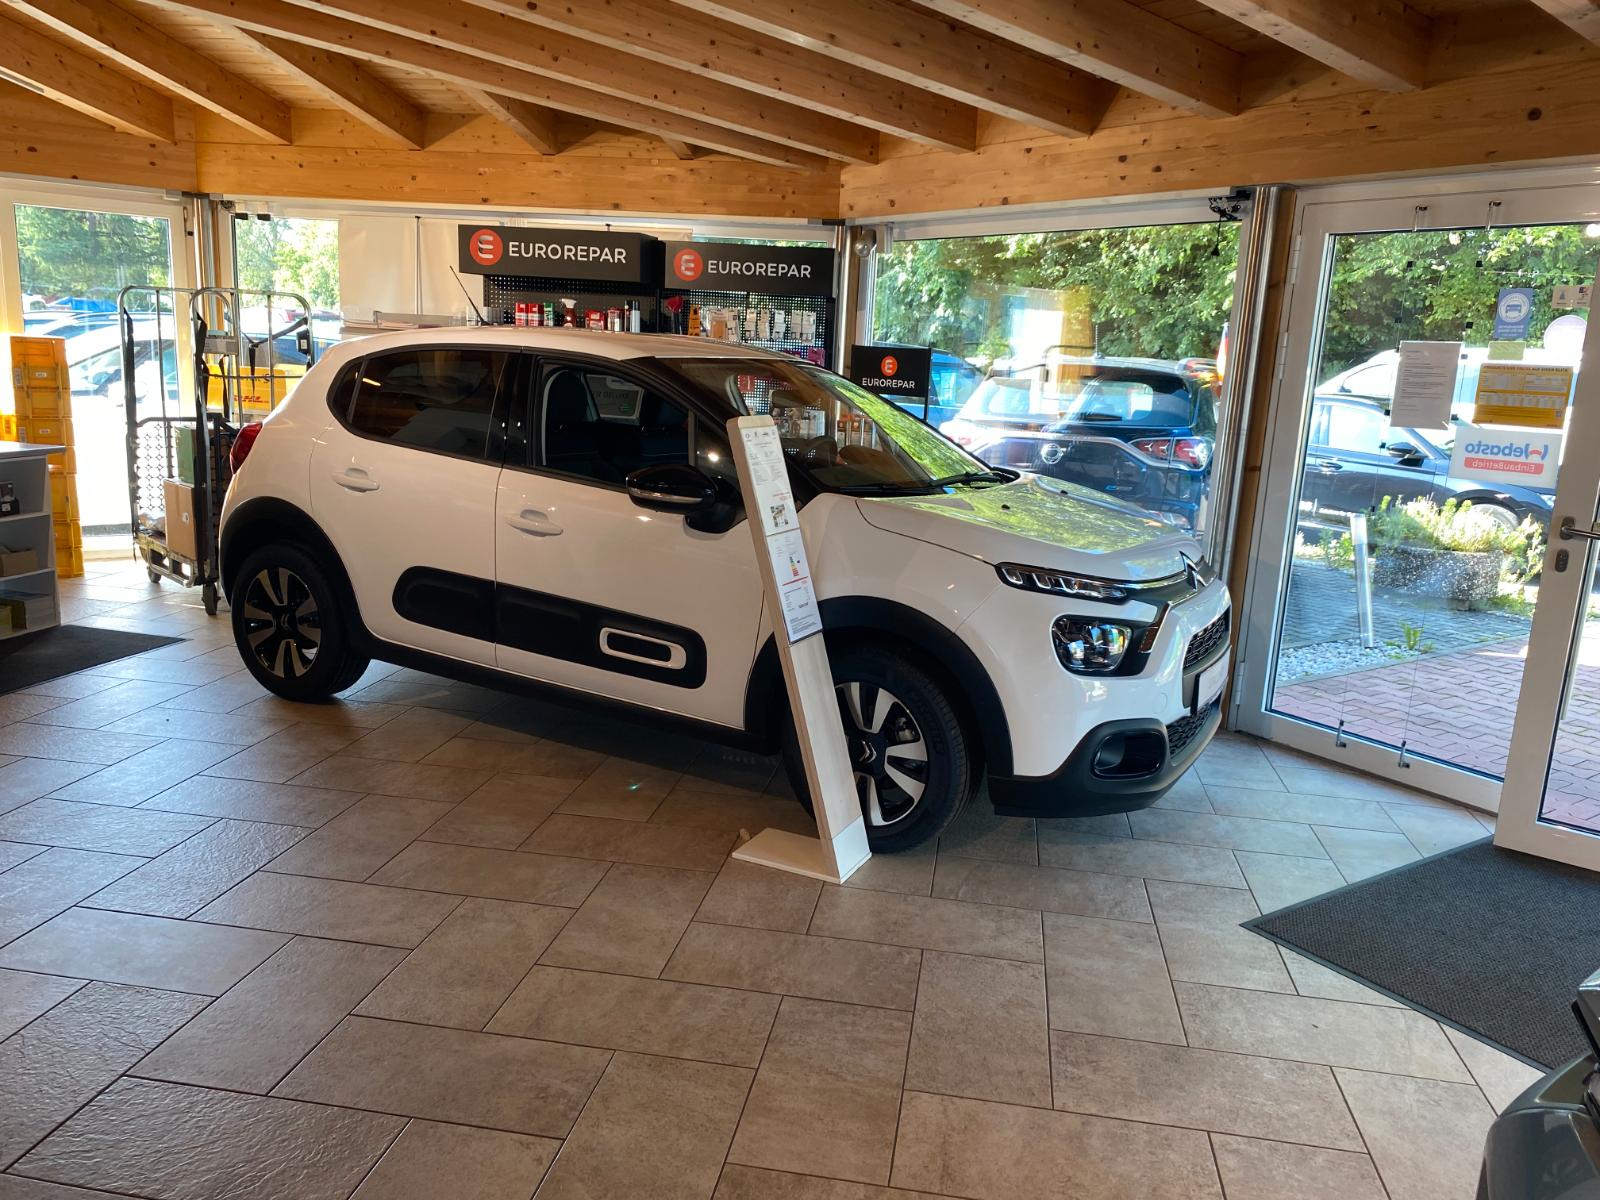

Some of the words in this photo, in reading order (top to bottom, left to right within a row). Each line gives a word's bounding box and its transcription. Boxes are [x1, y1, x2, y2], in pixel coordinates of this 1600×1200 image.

[508, 241, 627, 264] EUROREPAR
[707, 260, 812, 279] EUROREPAR
[862, 377, 916, 389] EUROREPAR
